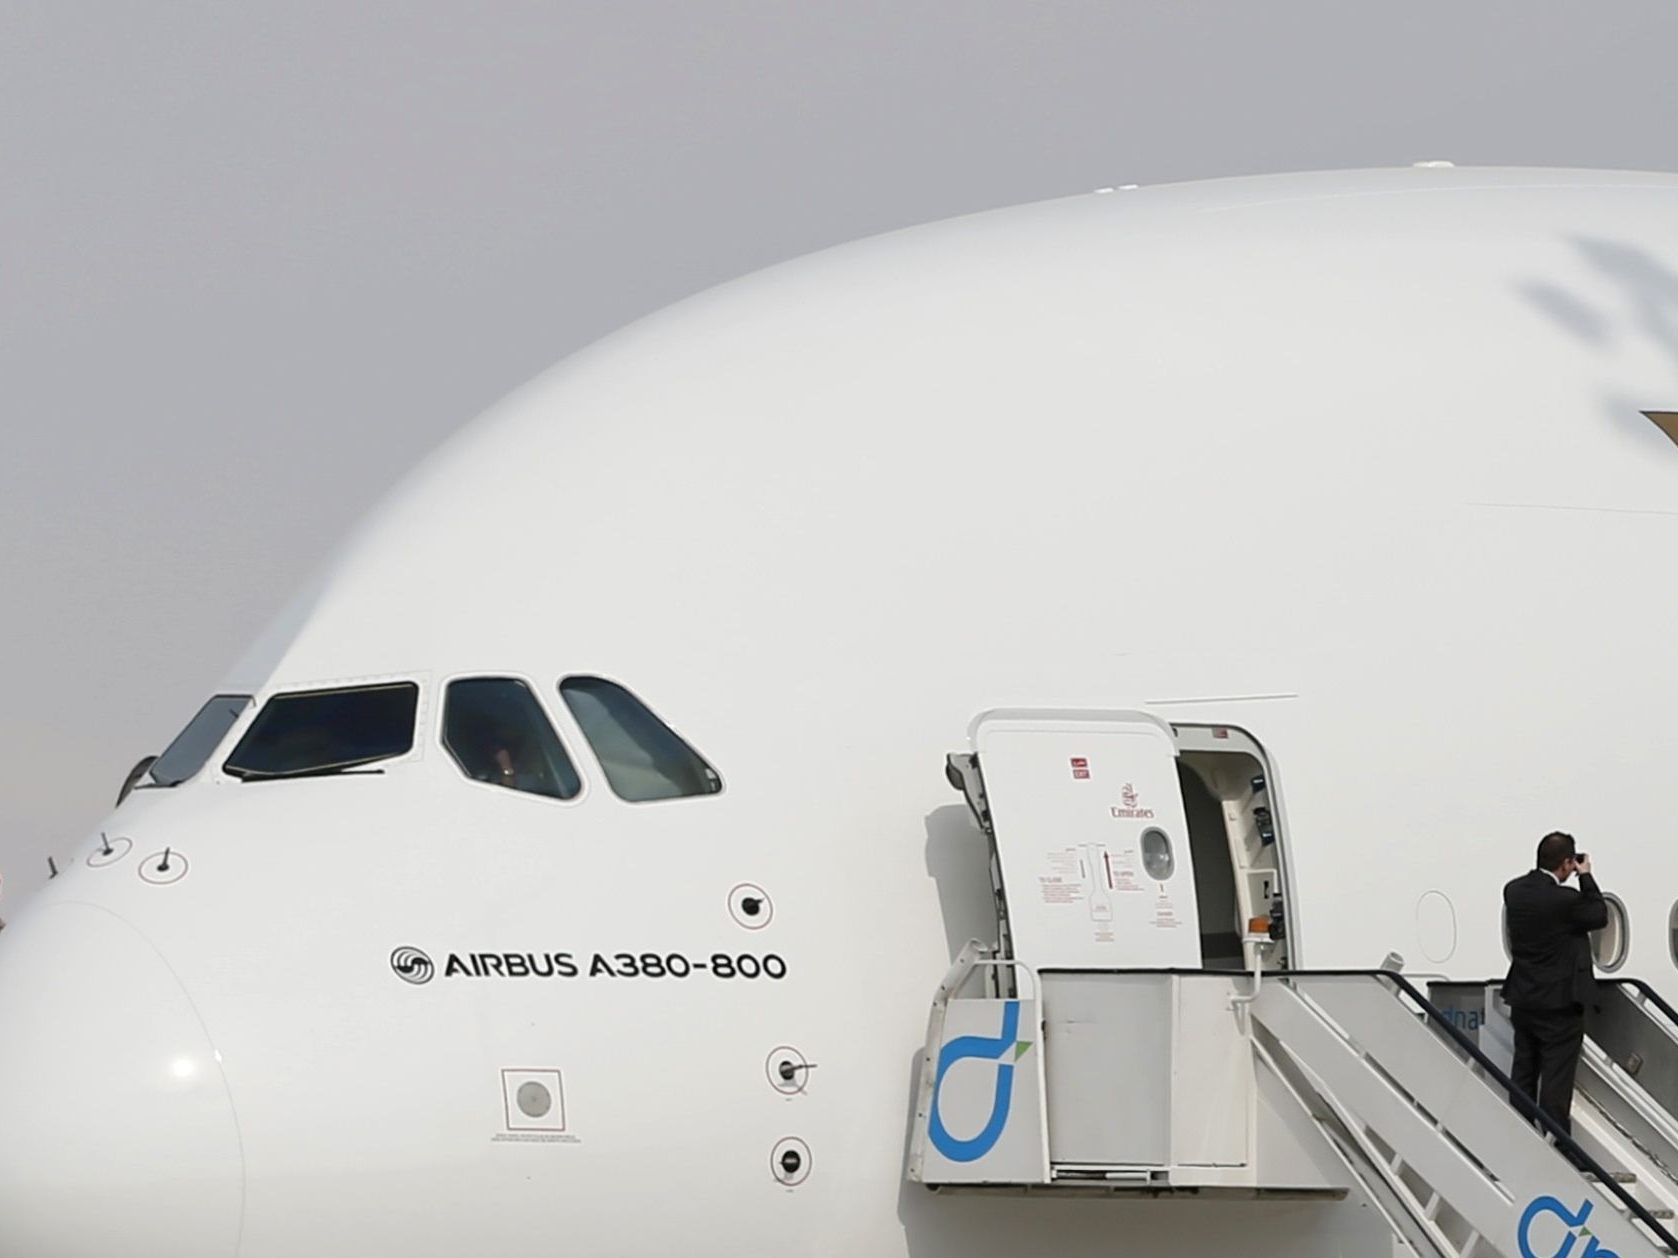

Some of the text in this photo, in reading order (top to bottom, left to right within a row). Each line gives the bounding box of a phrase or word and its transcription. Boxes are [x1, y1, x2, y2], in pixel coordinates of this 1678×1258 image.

[1111, 807, 1154, 818] Emirates
[445, 953, 788, 979] AIRBUS A380-800
